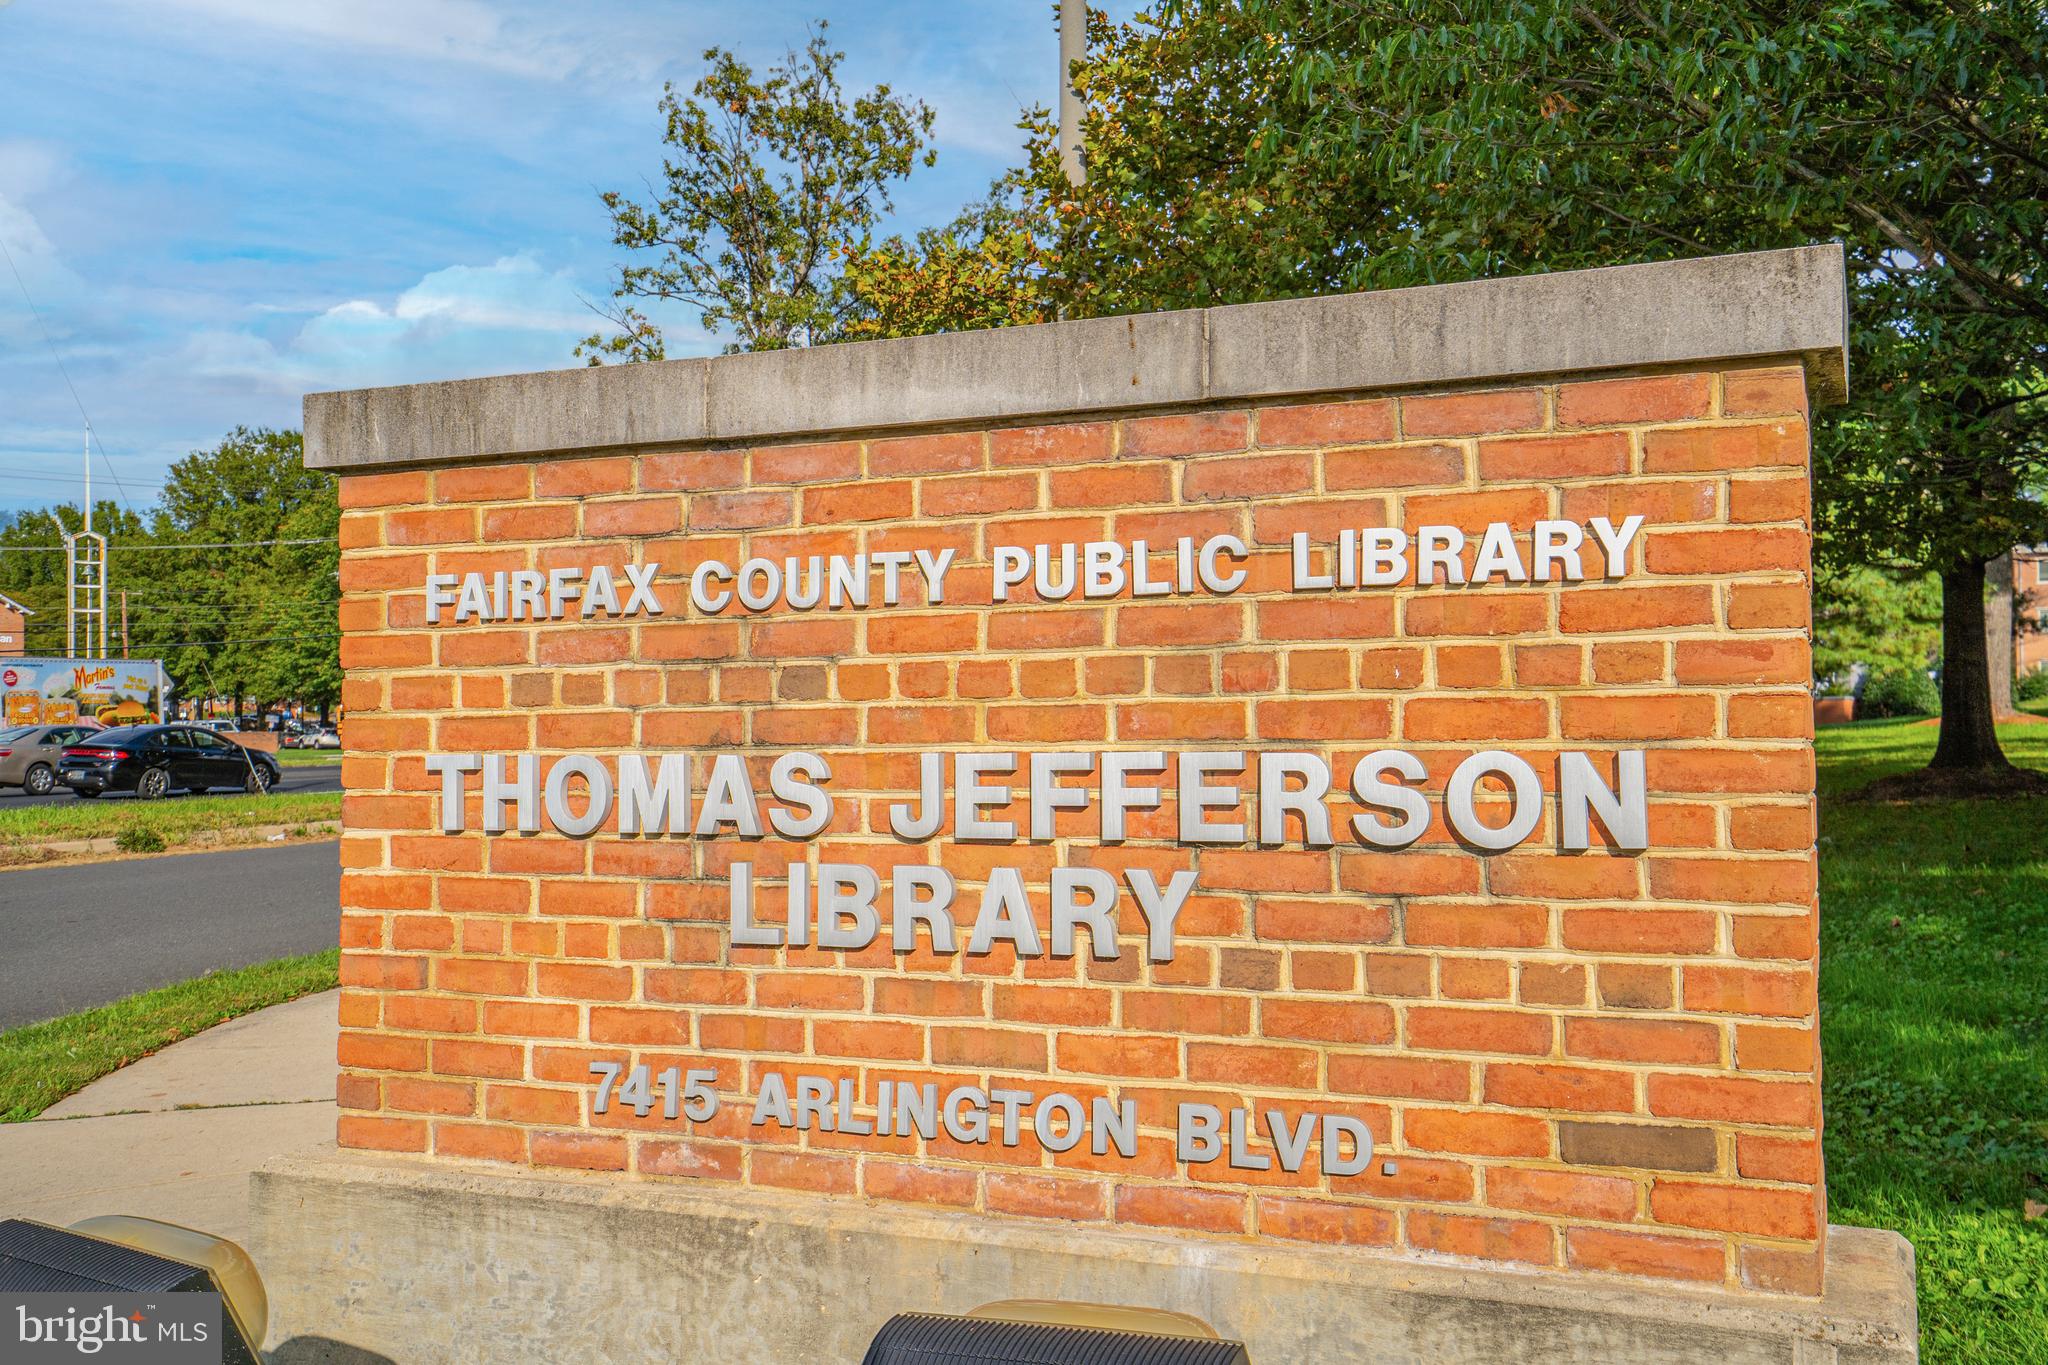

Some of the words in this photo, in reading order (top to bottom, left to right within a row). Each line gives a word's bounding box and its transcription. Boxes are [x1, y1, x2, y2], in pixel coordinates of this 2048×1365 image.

[425, 562, 664, 624] FAIRFAX
[690, 547, 957, 614] COUNTY
[992, 534, 1249, 600] PUBLIC
[1292, 515, 1645, 592] LIBRARY
[73, 665, 116, 689] Martin's
[425, 752, 834, 838] THOMAS
[889, 749, 1649, 852] JEFFERSON
[729, 861, 1200, 961] LIBRARY
[590, 1062, 720, 1122] 7415
[752, 1072, 1138, 1158] ARLINGTON
[1177, 1103, 1398, 1176] BLVD.
